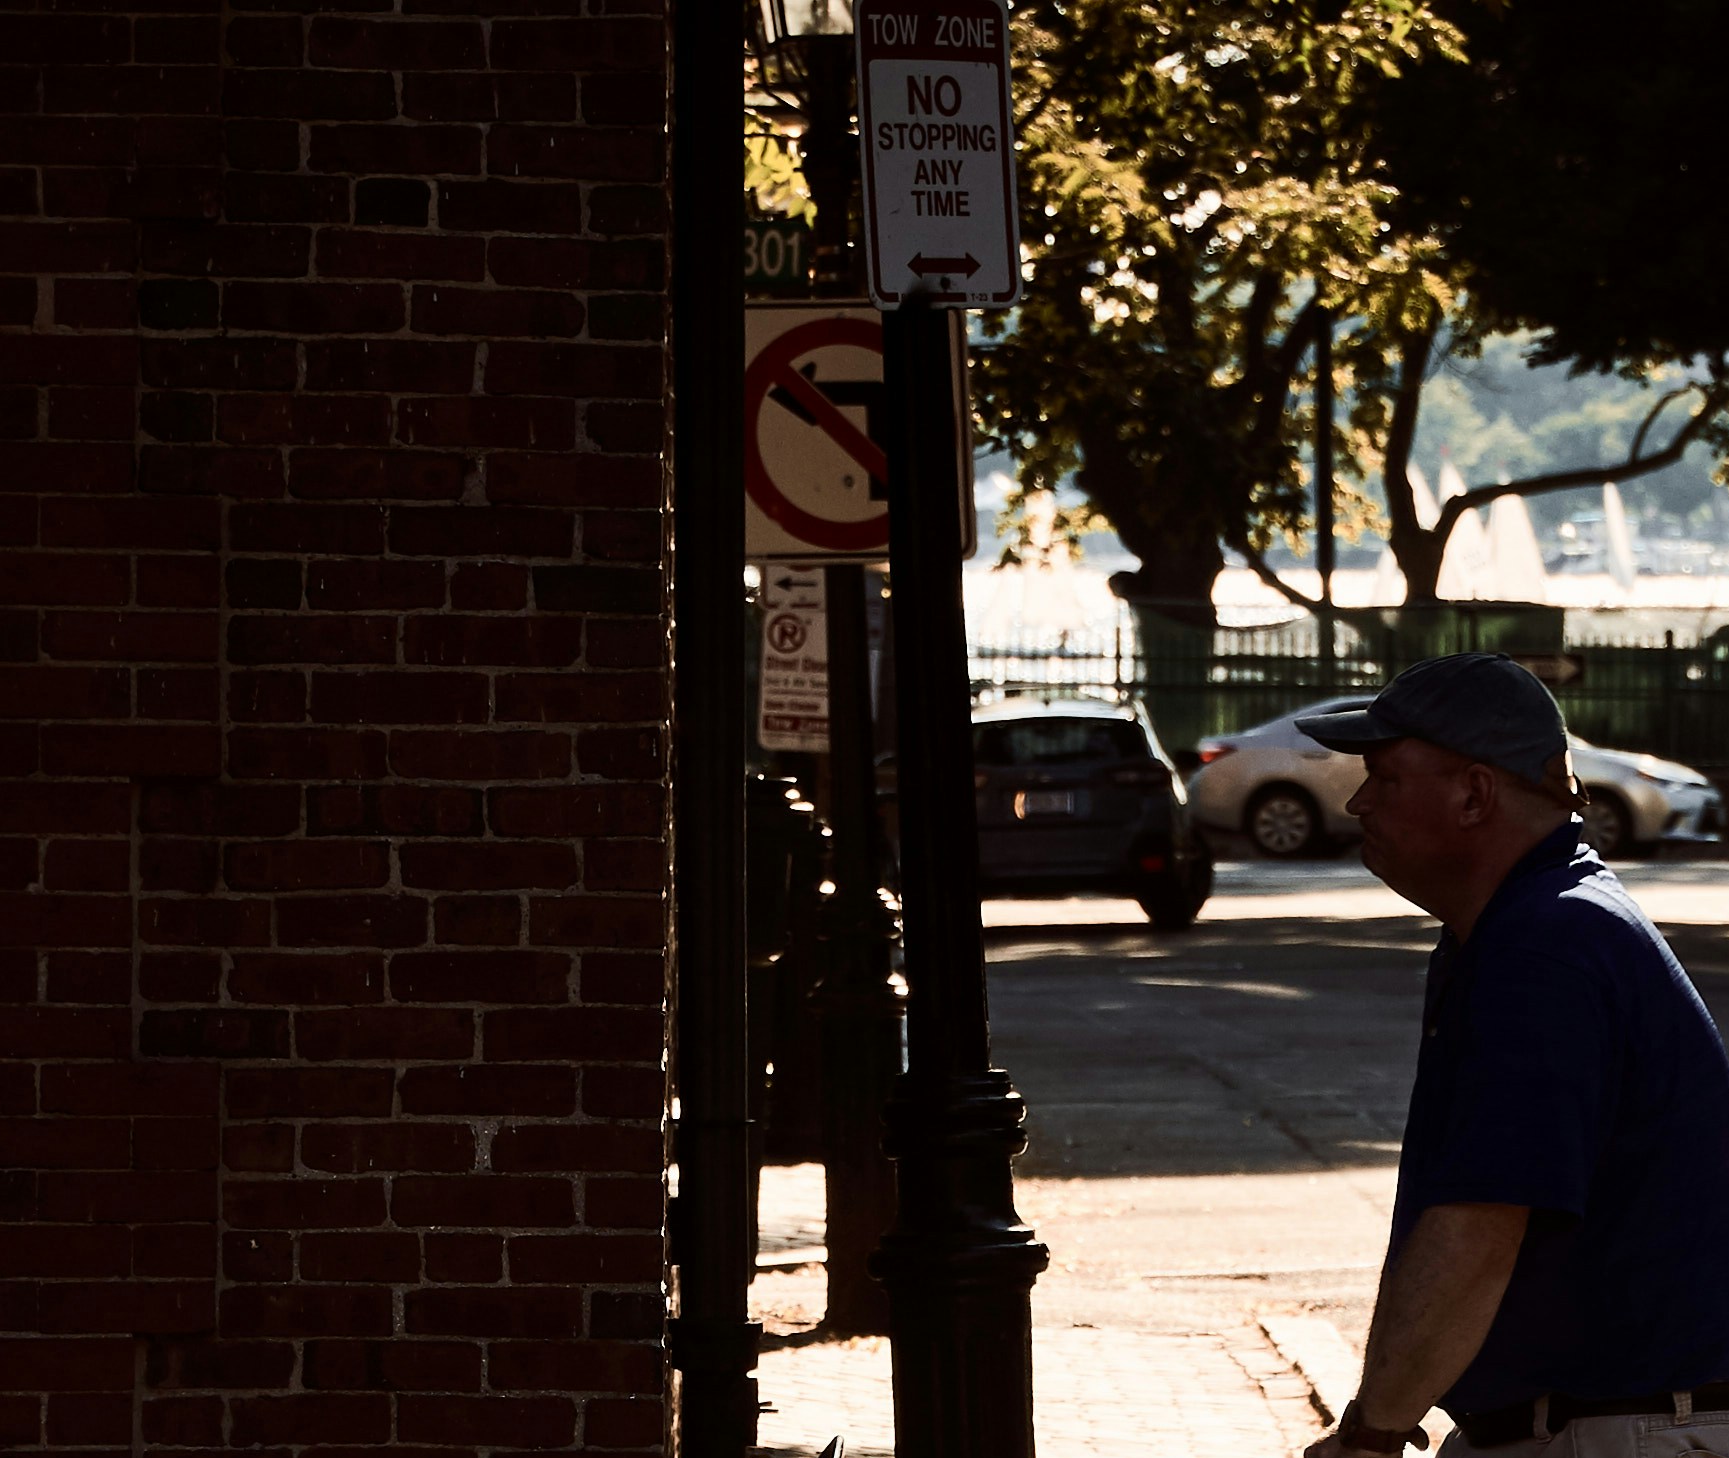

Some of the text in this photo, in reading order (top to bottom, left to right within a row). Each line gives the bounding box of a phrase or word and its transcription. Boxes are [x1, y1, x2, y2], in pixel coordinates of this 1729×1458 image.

[867, 13, 997, 49] TOW ZONE
[907, 75, 962, 117] NO
[878, 123, 996, 151] STOPPING
[914, 159, 963, 186] ANY
[911, 191, 970, 216] TIME
